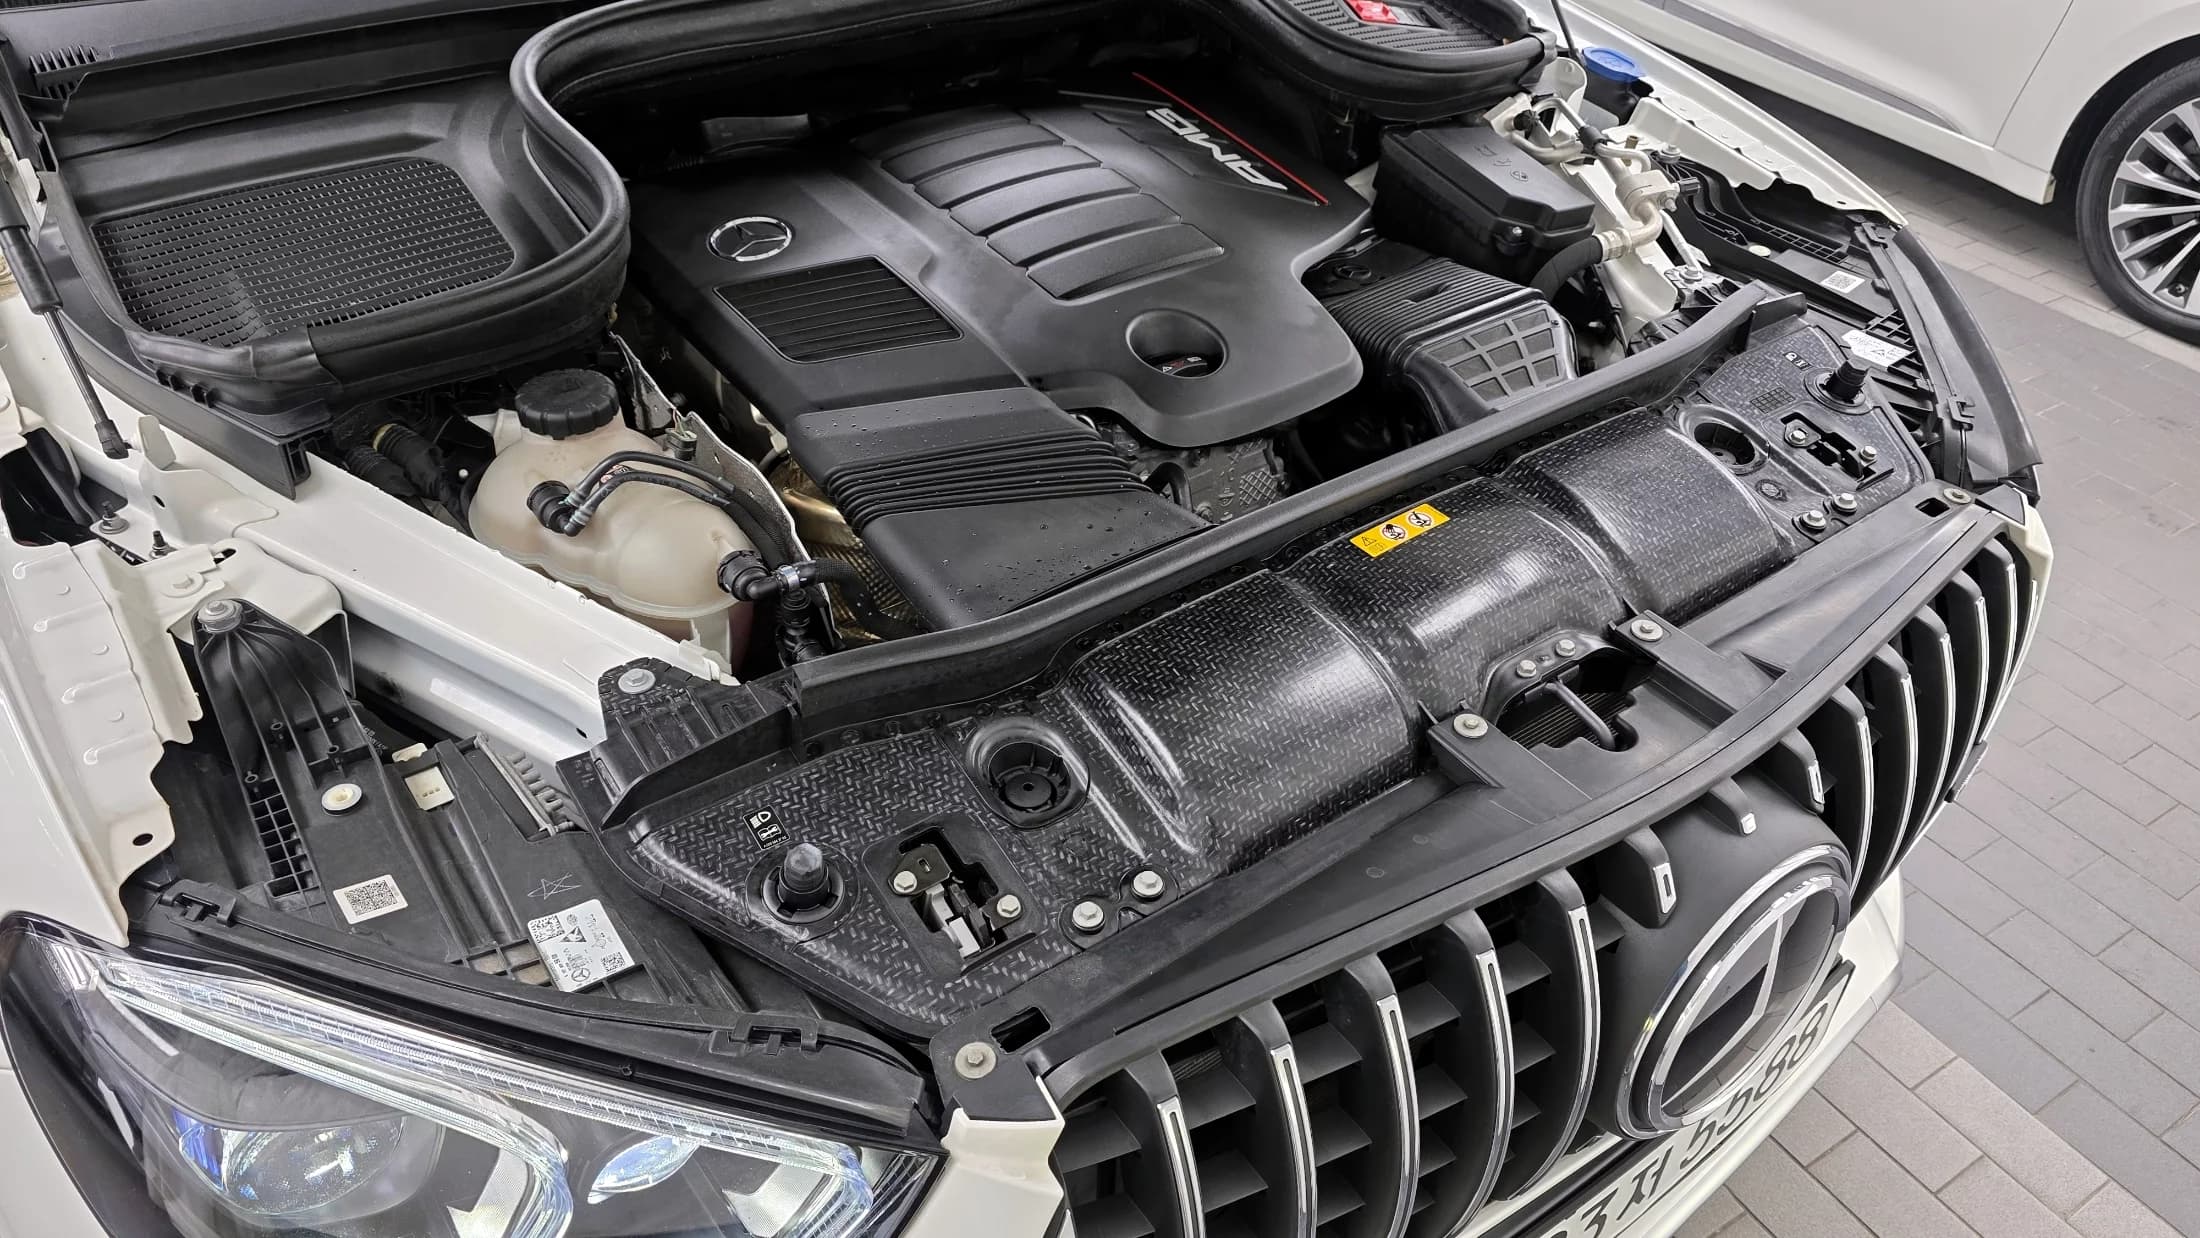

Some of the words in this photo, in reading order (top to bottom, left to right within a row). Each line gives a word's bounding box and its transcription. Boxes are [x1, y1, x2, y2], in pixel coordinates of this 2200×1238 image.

[1146, 108, 1288, 190] AMG
[1548, 1145, 1674, 1238] 3저
[1679, 1002, 1829, 1170] 5588
